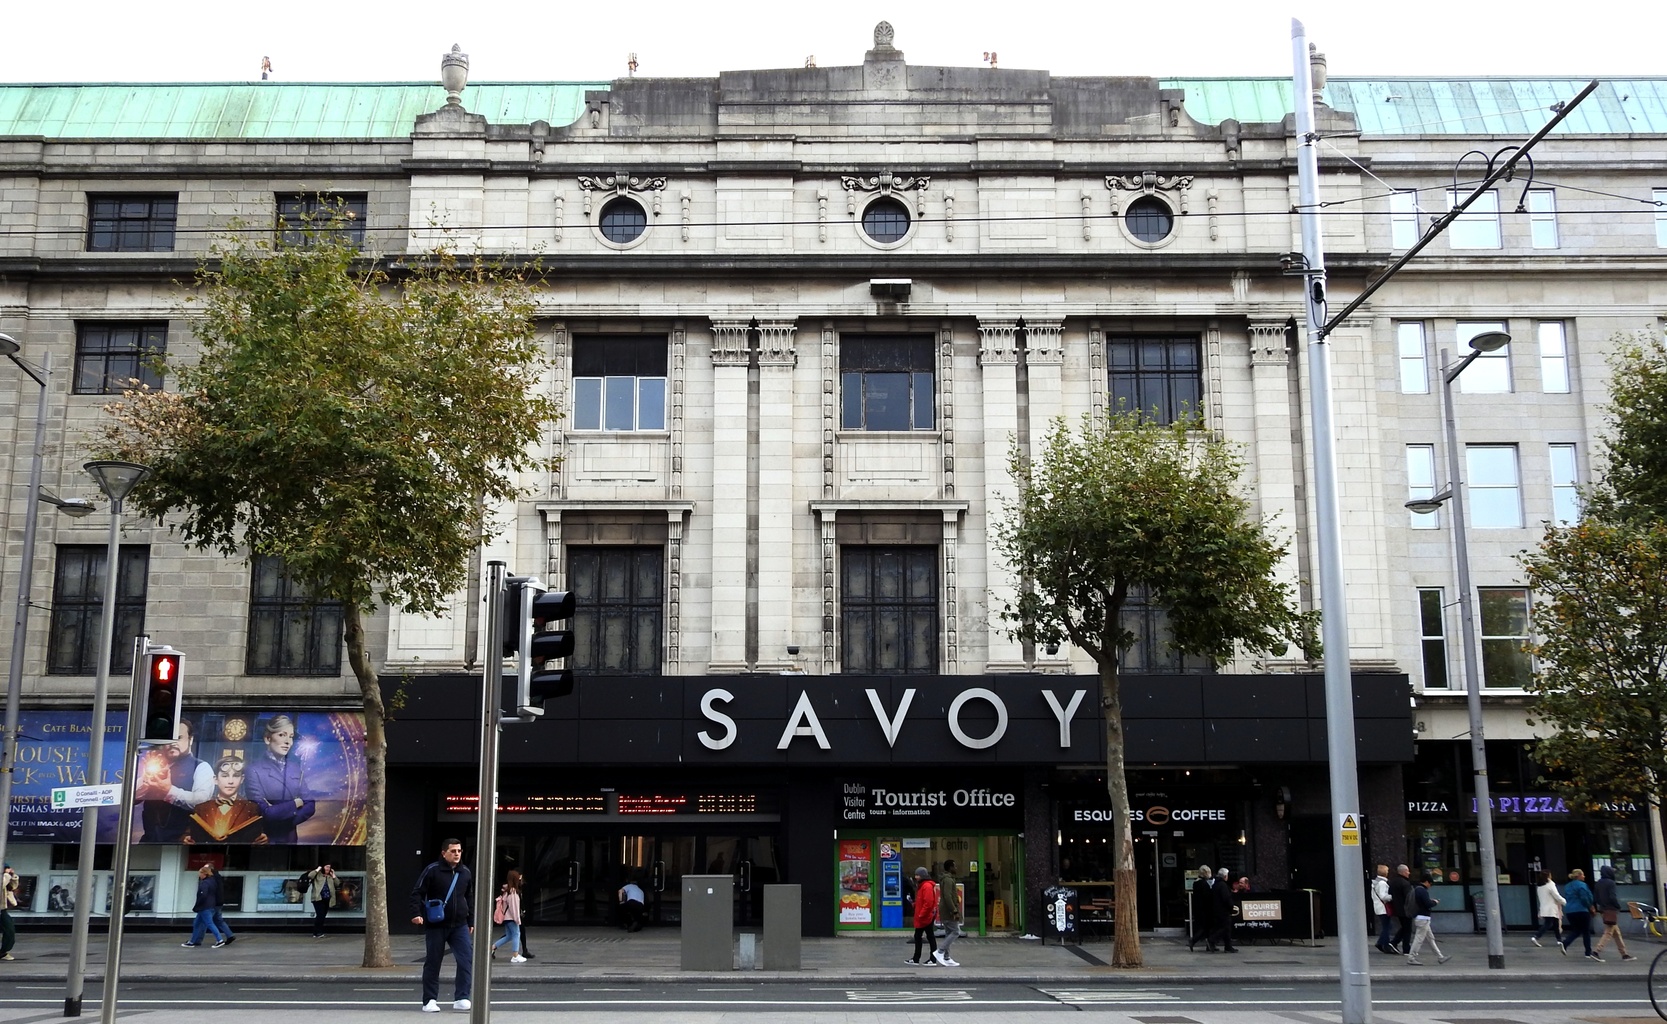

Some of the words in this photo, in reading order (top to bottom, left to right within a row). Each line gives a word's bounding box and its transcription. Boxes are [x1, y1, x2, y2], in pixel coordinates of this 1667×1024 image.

[697, 687, 1087, 751] SAVOY
[43, 724, 66, 733] CATE
[57, 765, 124, 785] WALS
[844, 783, 866, 794] Dublin
[844, 796, 866, 807] Visitor
[872, 787, 947, 806] Tourist
[953, 787, 1015, 807] Office
[1408, 801, 1448, 811] PIZZA
[1499, 797, 1569, 813] PIZZA
[843, 808, 866, 820] Centre
[1171, 809, 1226, 820] COFFEE
[941, 838, 969, 851] Centre
